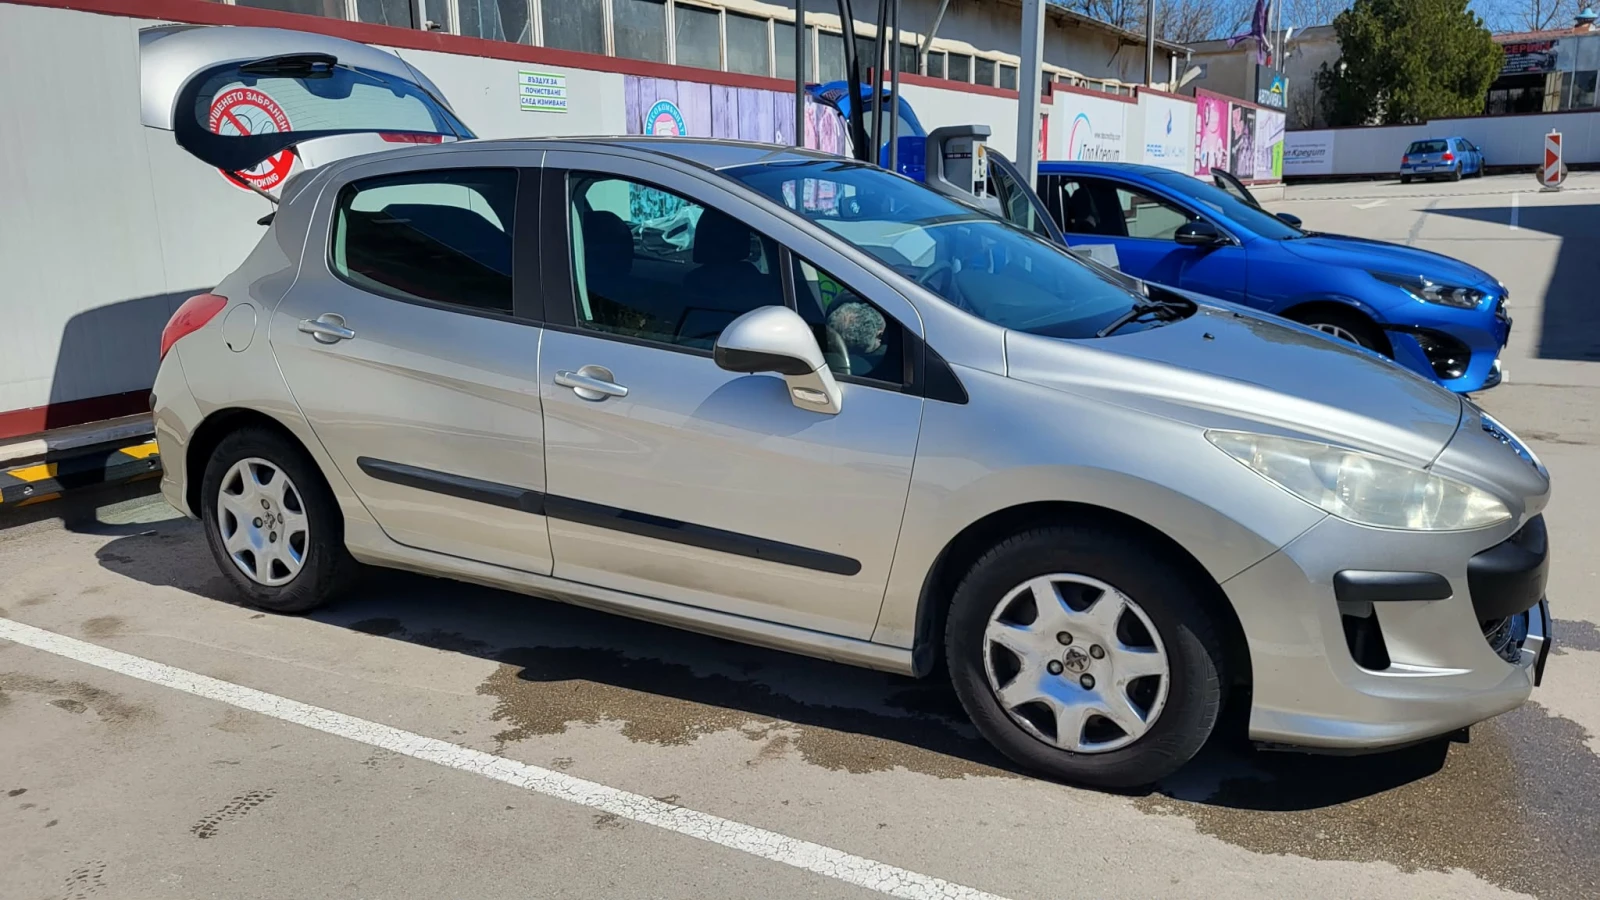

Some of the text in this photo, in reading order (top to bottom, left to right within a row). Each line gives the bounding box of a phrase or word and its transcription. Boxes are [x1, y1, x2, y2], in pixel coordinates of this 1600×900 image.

[527, 76, 549, 85] ВЪЗДУХ
[525, 87, 561, 96] ПОЧИСТВАНЕ
[521, 97, 566, 106] СЛЕД ИЗМИВАНЕ
[647, 103, 684, 132] МЕСОКОМБИНАТ
